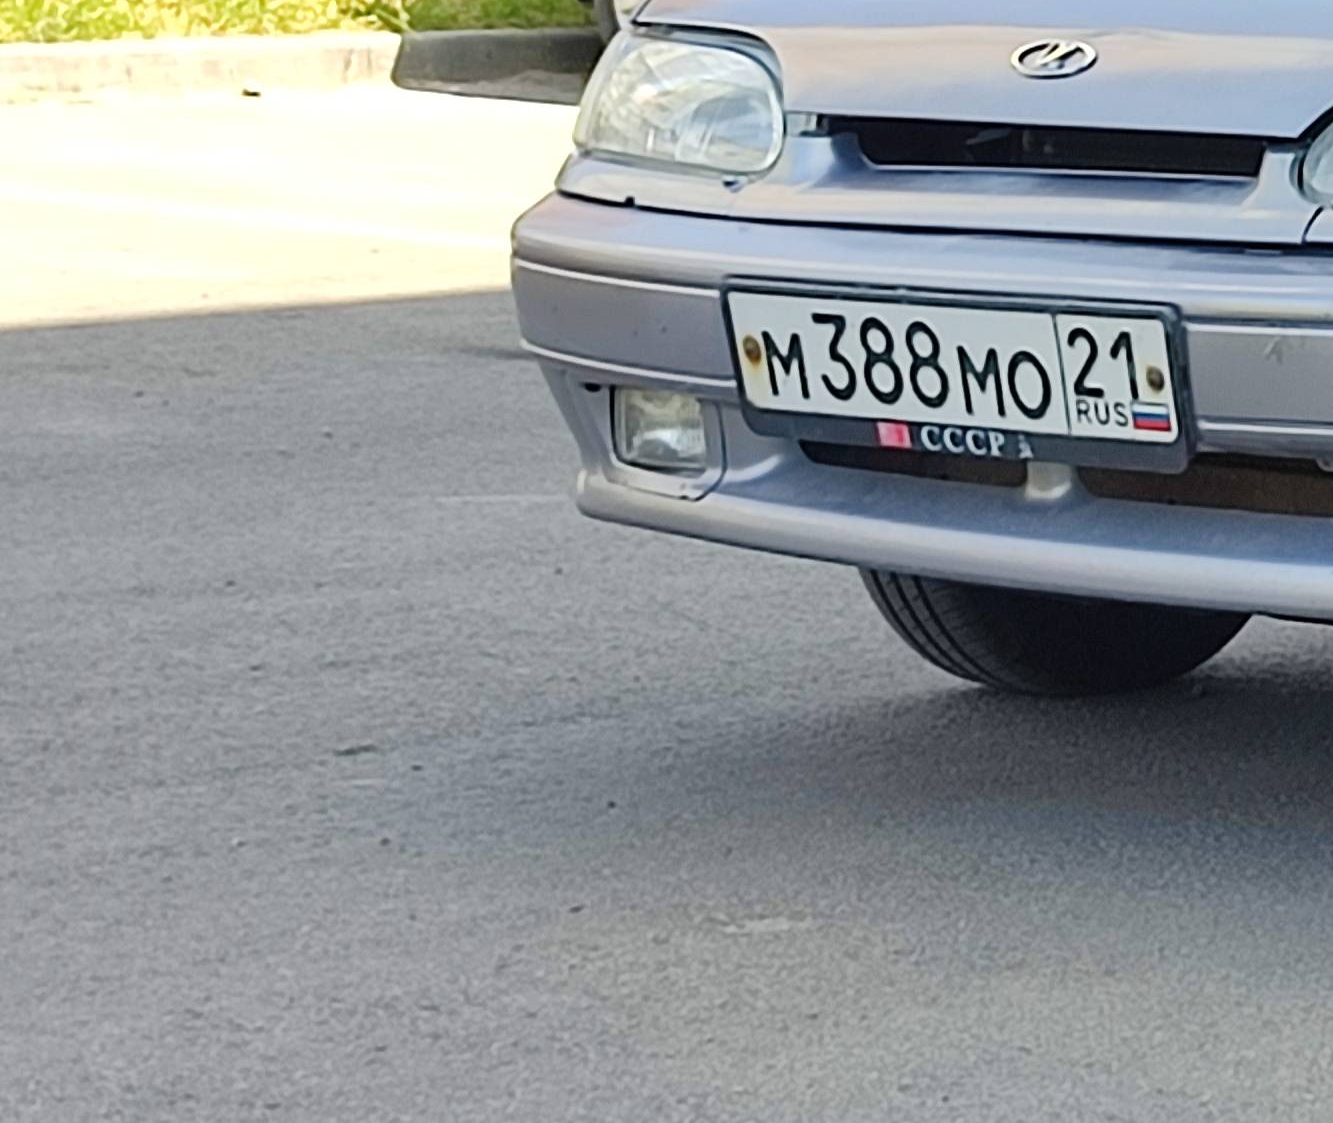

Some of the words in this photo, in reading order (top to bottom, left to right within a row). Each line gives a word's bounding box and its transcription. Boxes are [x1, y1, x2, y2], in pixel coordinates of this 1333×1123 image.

[761, 312, 1051, 420] М388МО
[1067, 326, 1139, 400] 21
[1075, 398, 1129, 427] RUS
[920, 425, 1005, 458] СССР
